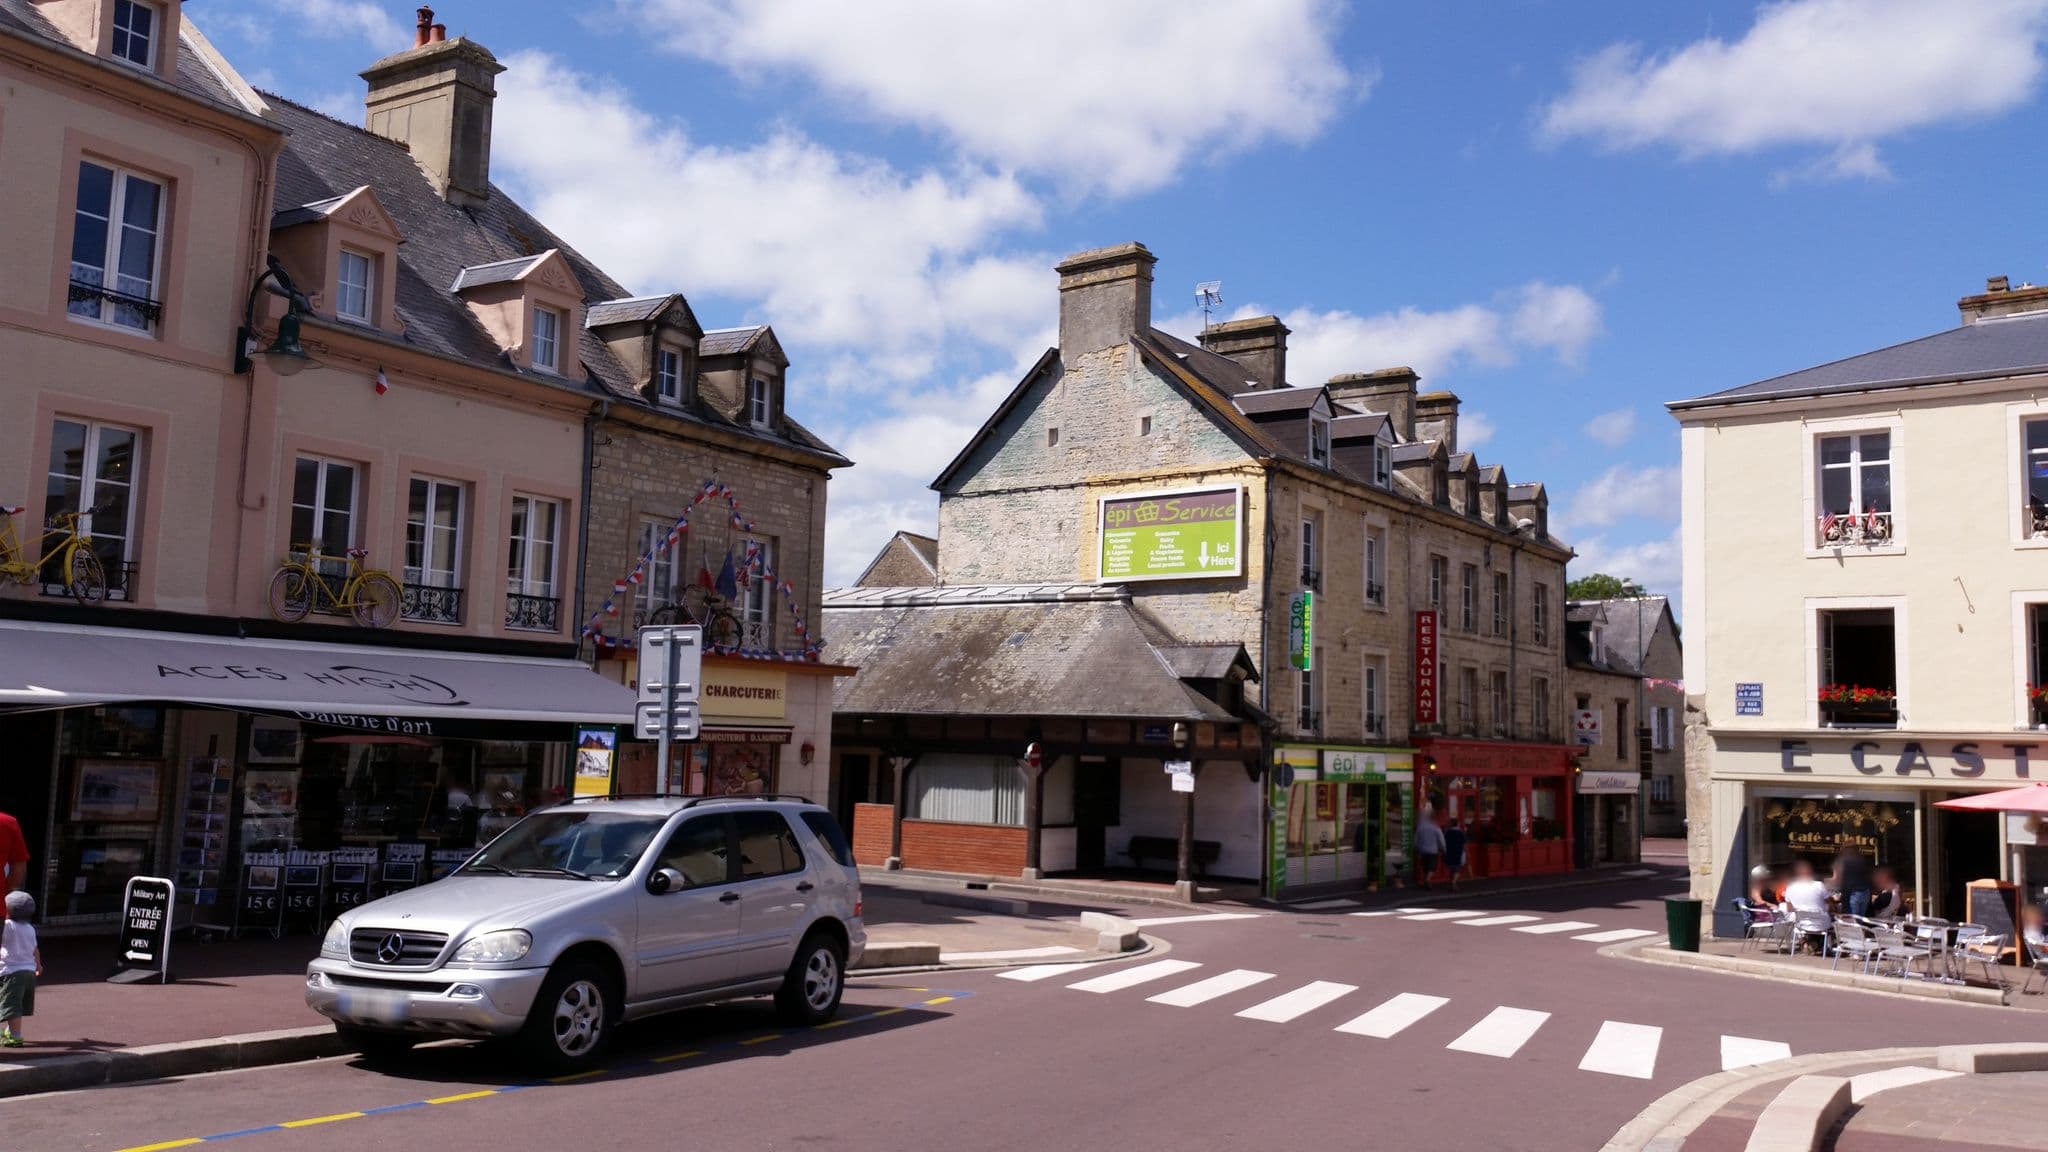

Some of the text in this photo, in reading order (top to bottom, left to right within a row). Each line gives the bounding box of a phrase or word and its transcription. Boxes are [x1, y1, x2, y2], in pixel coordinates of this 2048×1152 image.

[1105, 499, 1236, 527] épi Service
[1216, 542, 1230, 553] Ici
[1210, 556, 1235, 567] Here
[1290, 597, 1303, 651] épi
[1420, 615, 1432, 719] RESTAURANT
[157, 664, 433, 692] ACES HIGH
[705, 684, 782, 700] CHARCUTERIE
[1333, 754, 1357, 776] épi
[1781, 740, 2040, 779] E CAST
[1788, 831, 1822, 842] Café
[133, 889, 166, 900] Military Art
[335, 891, 350, 903] 15
[247, 896, 276, 909] 15 €
[288, 895, 302, 908] 15
[129, 906, 162, 919] ENTRÉE
[131, 918, 157, 930] LIBRE!
[131, 938, 149, 948] OPEN
